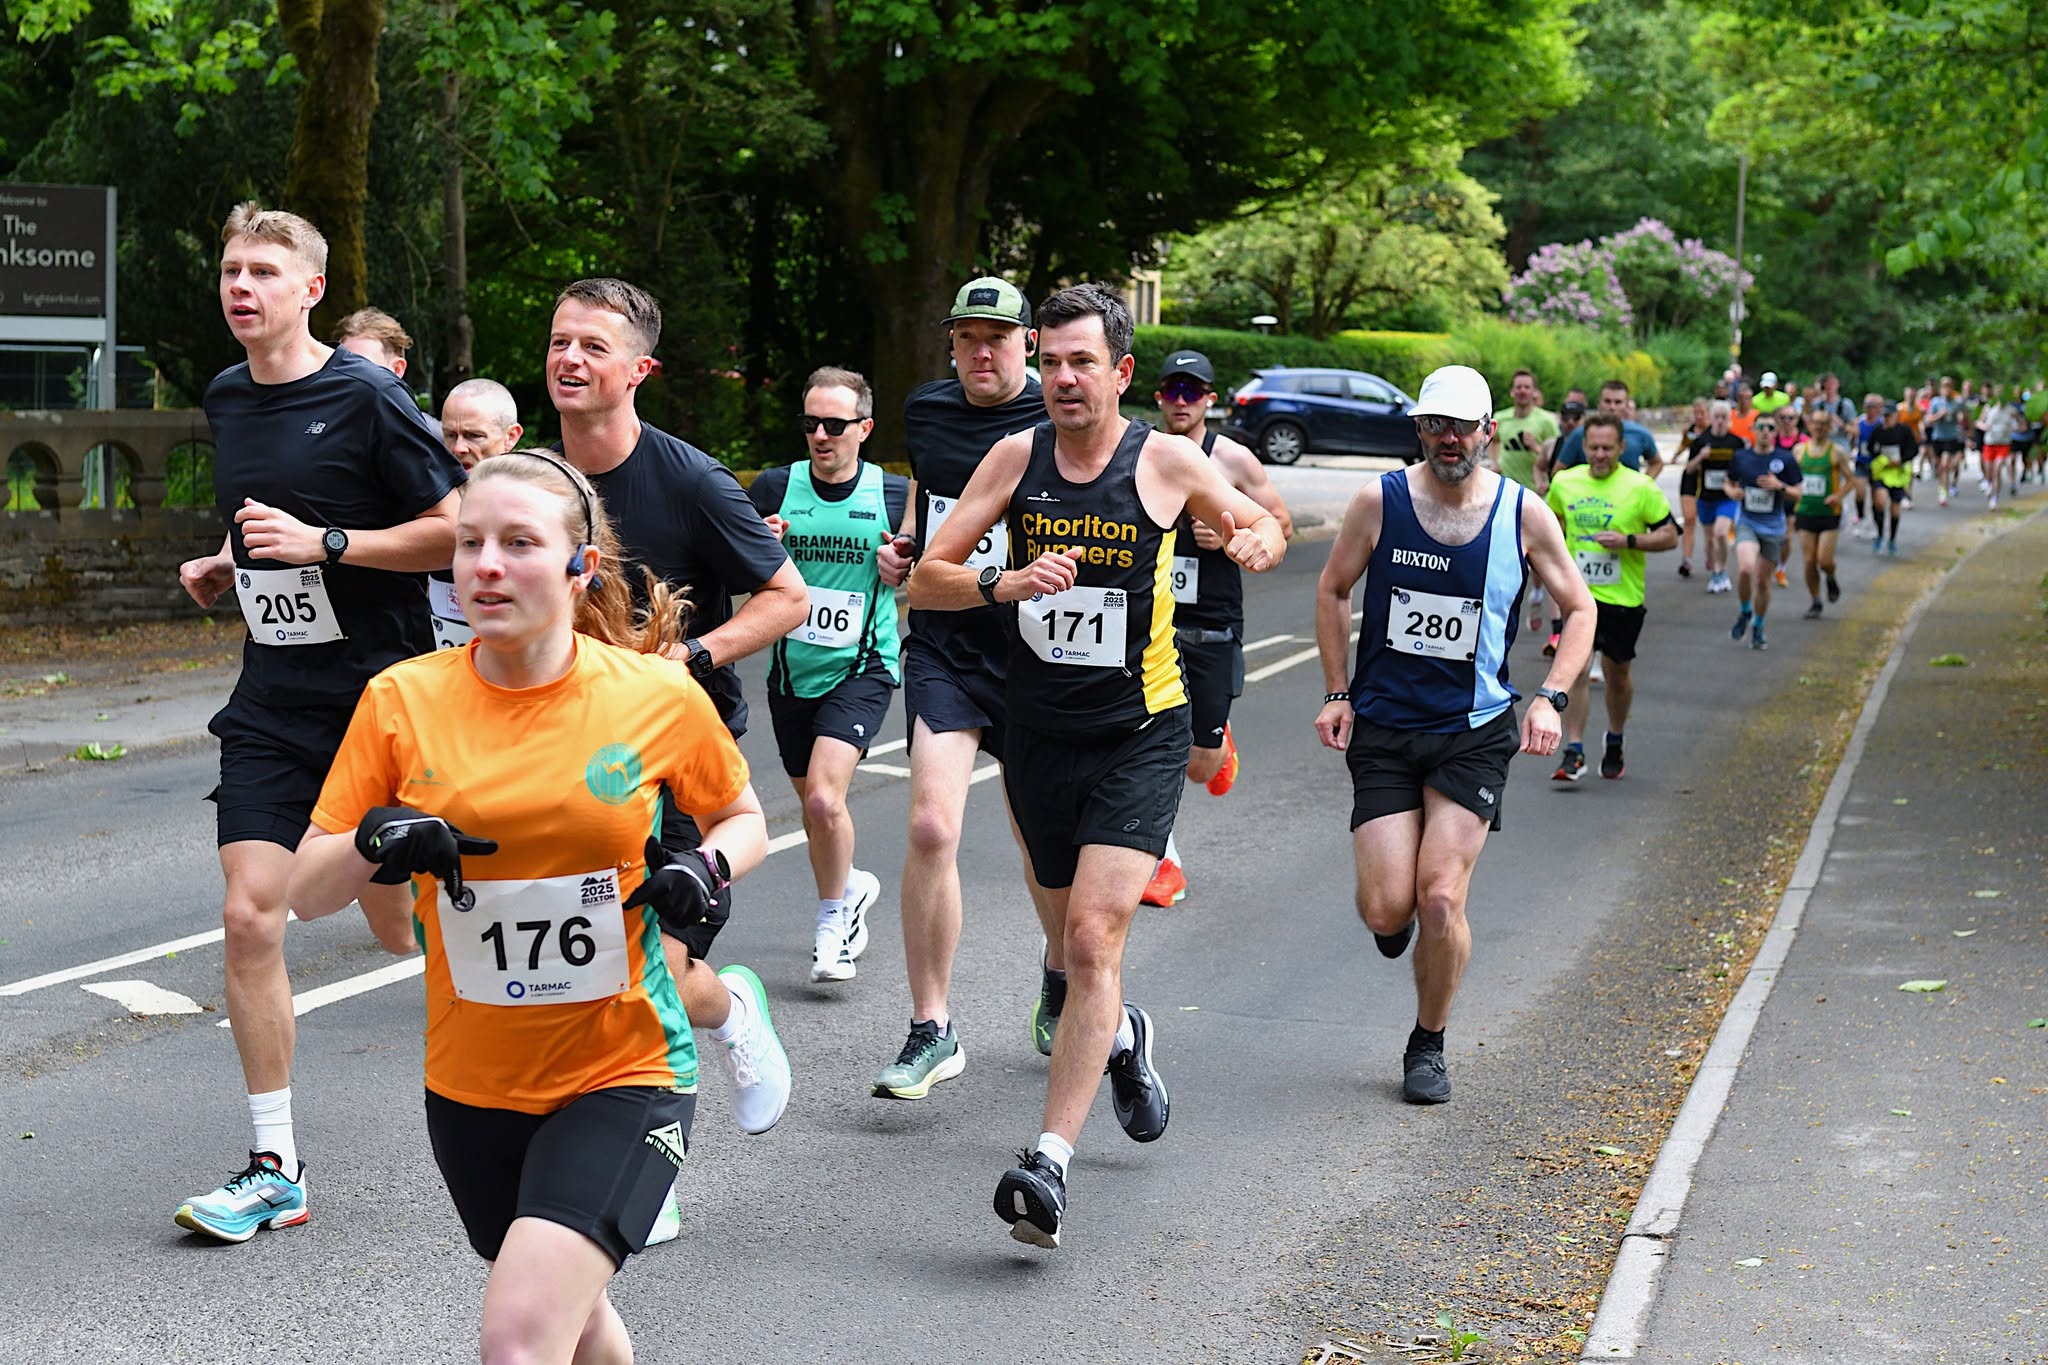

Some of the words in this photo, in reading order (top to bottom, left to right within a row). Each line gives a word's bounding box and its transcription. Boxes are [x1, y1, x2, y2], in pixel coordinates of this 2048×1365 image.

[3, 214, 37, 235] The
[1022, 513, 1138, 543] Chorlton
[789, 535, 870, 551] BRAMHALL
[794, 549, 865, 564] RUNNERS
[1392, 548, 1451, 572] BUXTON
[1583, 562, 1613, 576] 476
[300, 574, 320, 582] 2025
[1171, 571, 1187, 590] 9
[255, 592, 317, 625] 205
[1104, 596, 1124, 604] 2025
[806, 604, 850, 632] 106
[1404, 611, 1463, 642] 280
[1041, 609, 1104, 645] 171
[1065, 650, 1091, 658] TARMAC
[580, 882, 614, 898] 2025
[581, 893, 616, 905] BUXTON
[480, 915, 596, 971] 176
[528, 981, 572, 992] TARMAC
